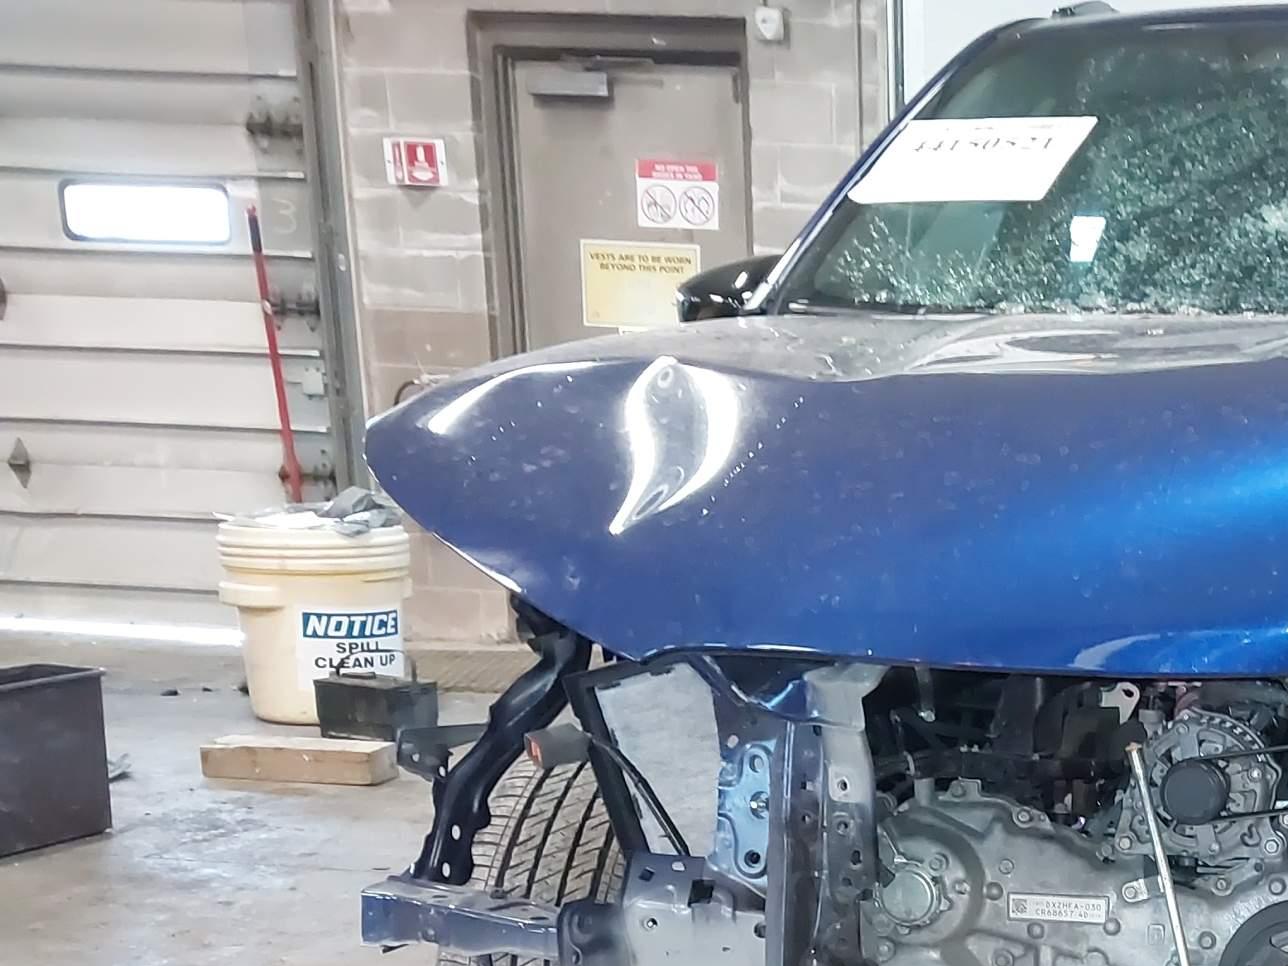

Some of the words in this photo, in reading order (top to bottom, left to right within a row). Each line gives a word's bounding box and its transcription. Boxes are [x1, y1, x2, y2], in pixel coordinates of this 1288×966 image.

[589, 252, 616, 261] VESTS
[619, 253, 635, 262] ARE
[638, 254, 649, 263] TO
[664, 256, 692, 265] WORN
[600, 262, 636, 272] BEYOND
[639, 264, 657, 272] THIS
[659, 265, 685, 274] POINT
[305, 611, 397, 637] NOTICE
[336, 640, 381, 655] SPILL
[314, 655, 375, 669] CLEAN
[379, 653, 396, 667] UP
